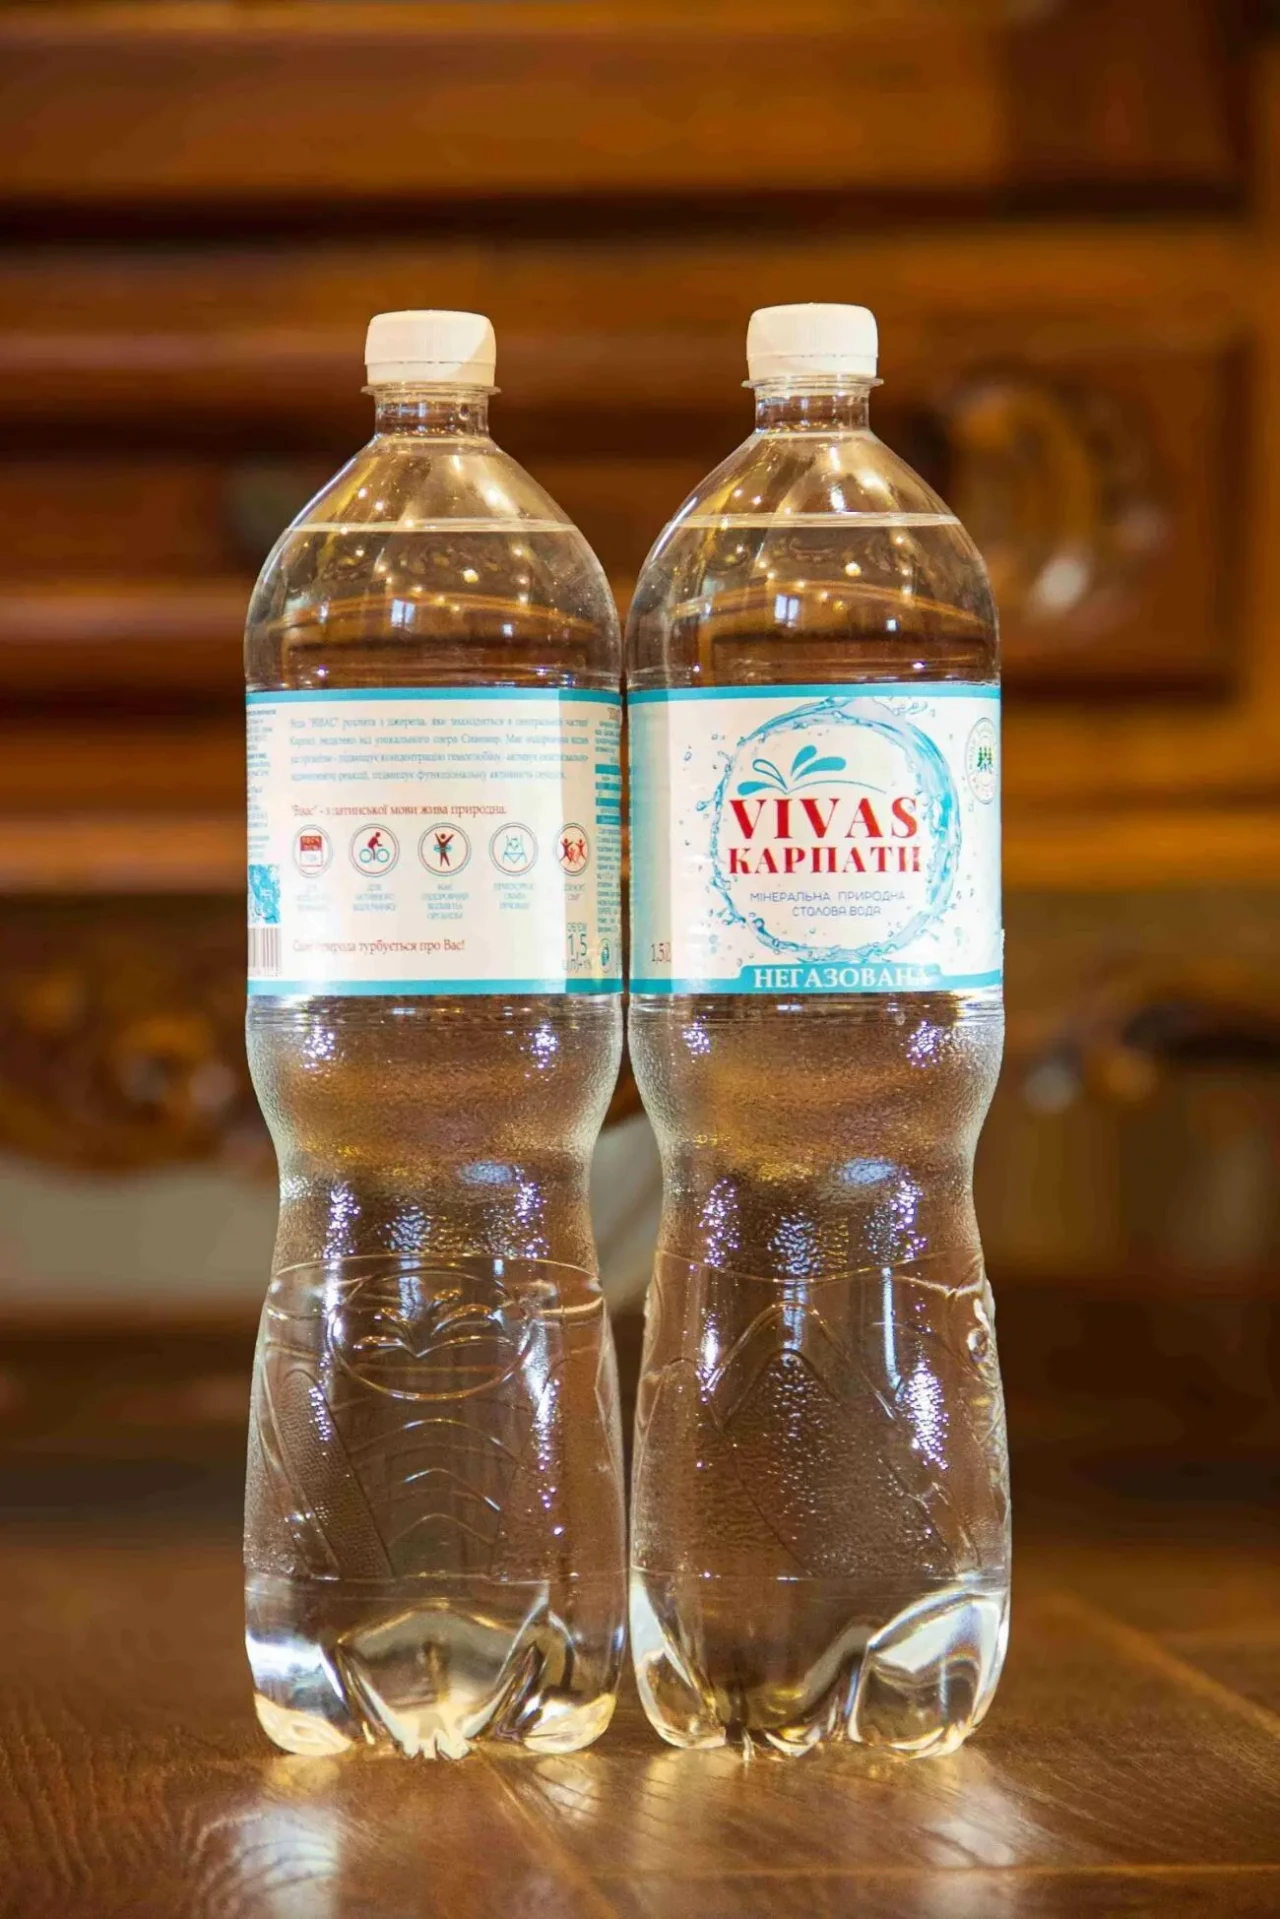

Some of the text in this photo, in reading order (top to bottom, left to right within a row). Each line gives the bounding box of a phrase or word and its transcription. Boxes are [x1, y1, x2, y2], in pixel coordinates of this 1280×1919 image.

[729, 797, 918, 839] VIVAS
[728, 846, 921, 874] КАРПАТИ
[750, 890, 906, 902] МІНЕРАЛЬНА ПРИРОДНА
[792, 905, 881, 917] СТОЛОВА ВОДА
[568, 933, 588, 961] 1,5
